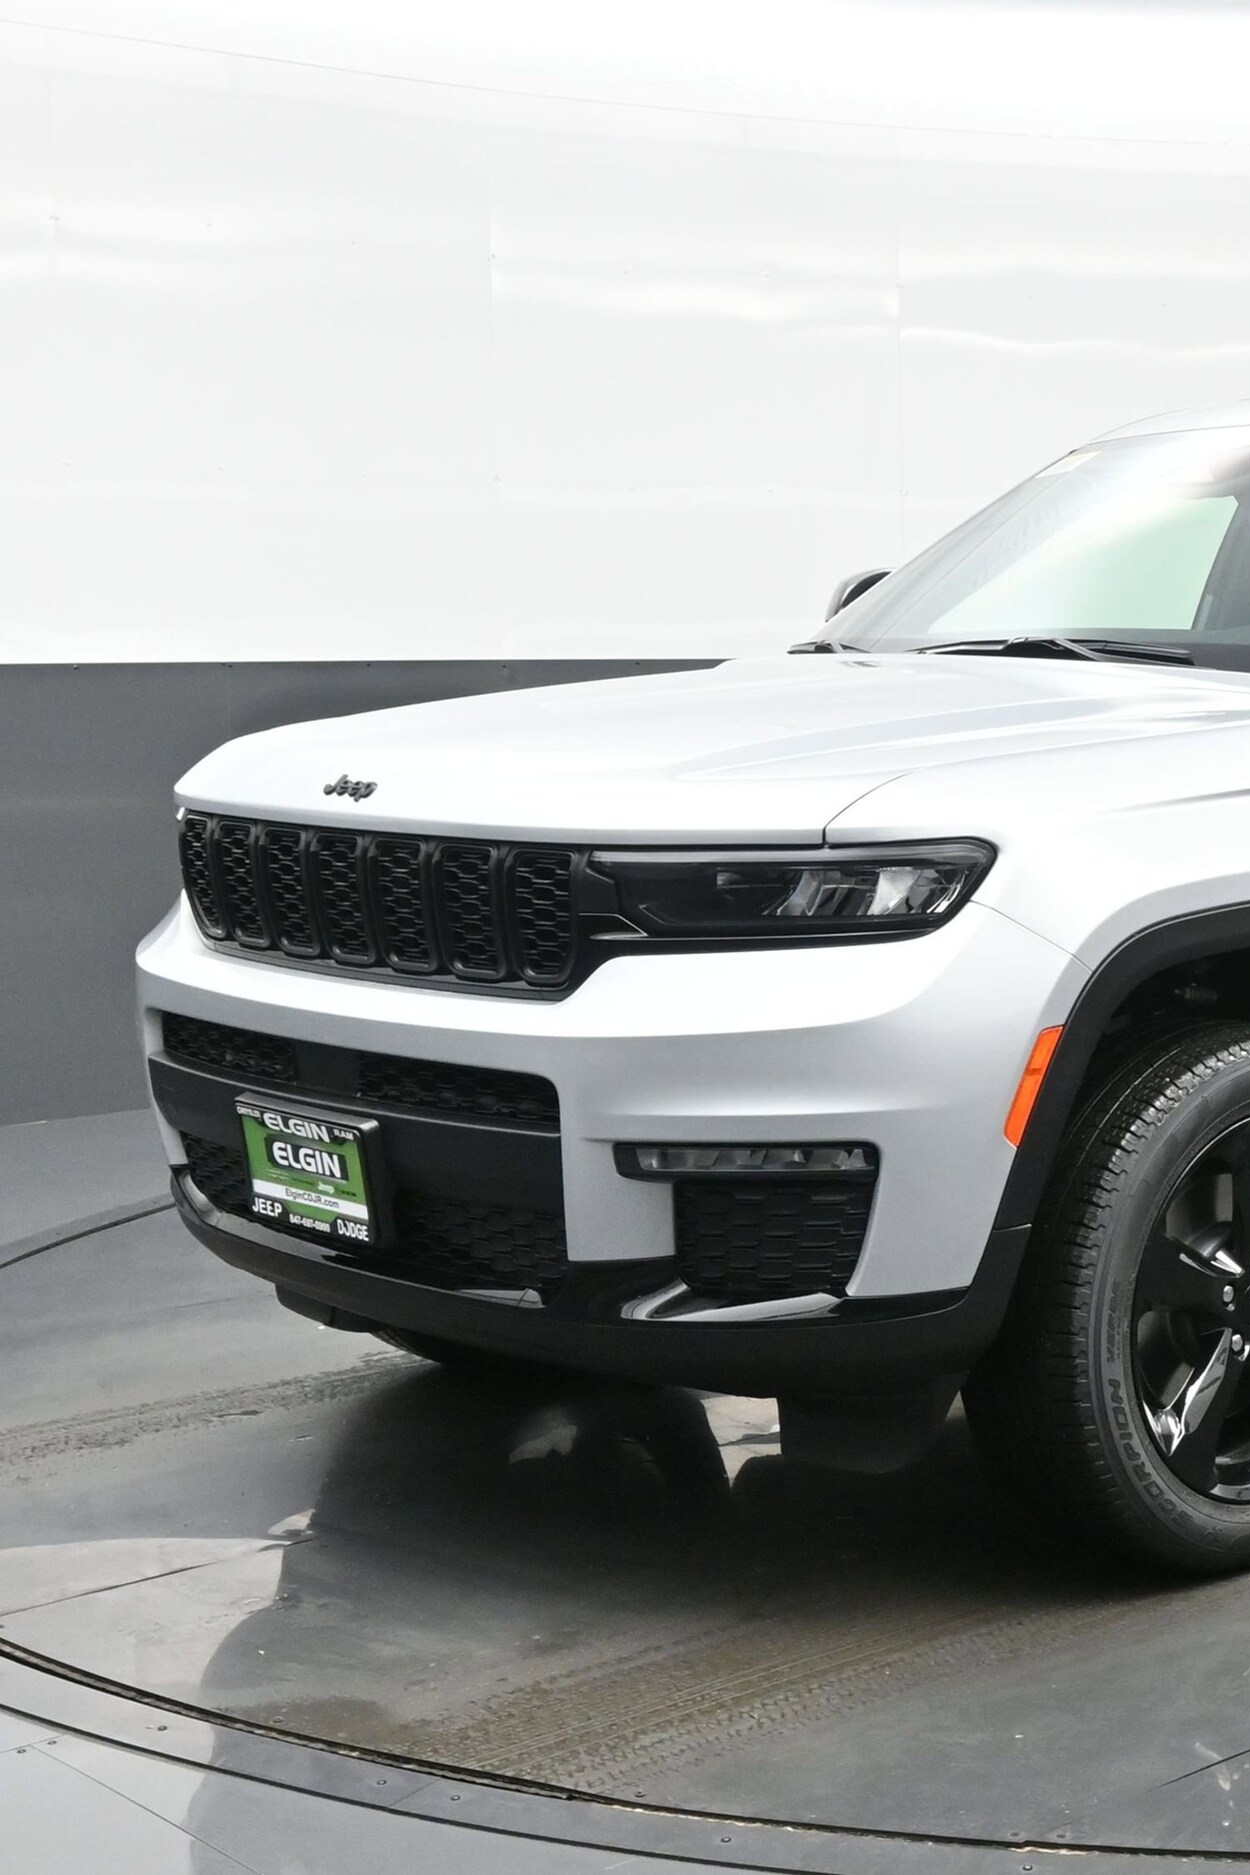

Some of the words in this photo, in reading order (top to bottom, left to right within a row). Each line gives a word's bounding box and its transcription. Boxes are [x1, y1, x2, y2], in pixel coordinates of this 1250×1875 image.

[323, 774, 378, 803] Jeep
[263, 1112, 330, 1143] ELGIN
[272, 1141, 342, 1178] ELGIN
[252, 1197, 283, 1217] JEEP
[285, 1188, 340, 1209] ElginCDJR.com
[1108, 1378, 1194, 1529] SCORPION
